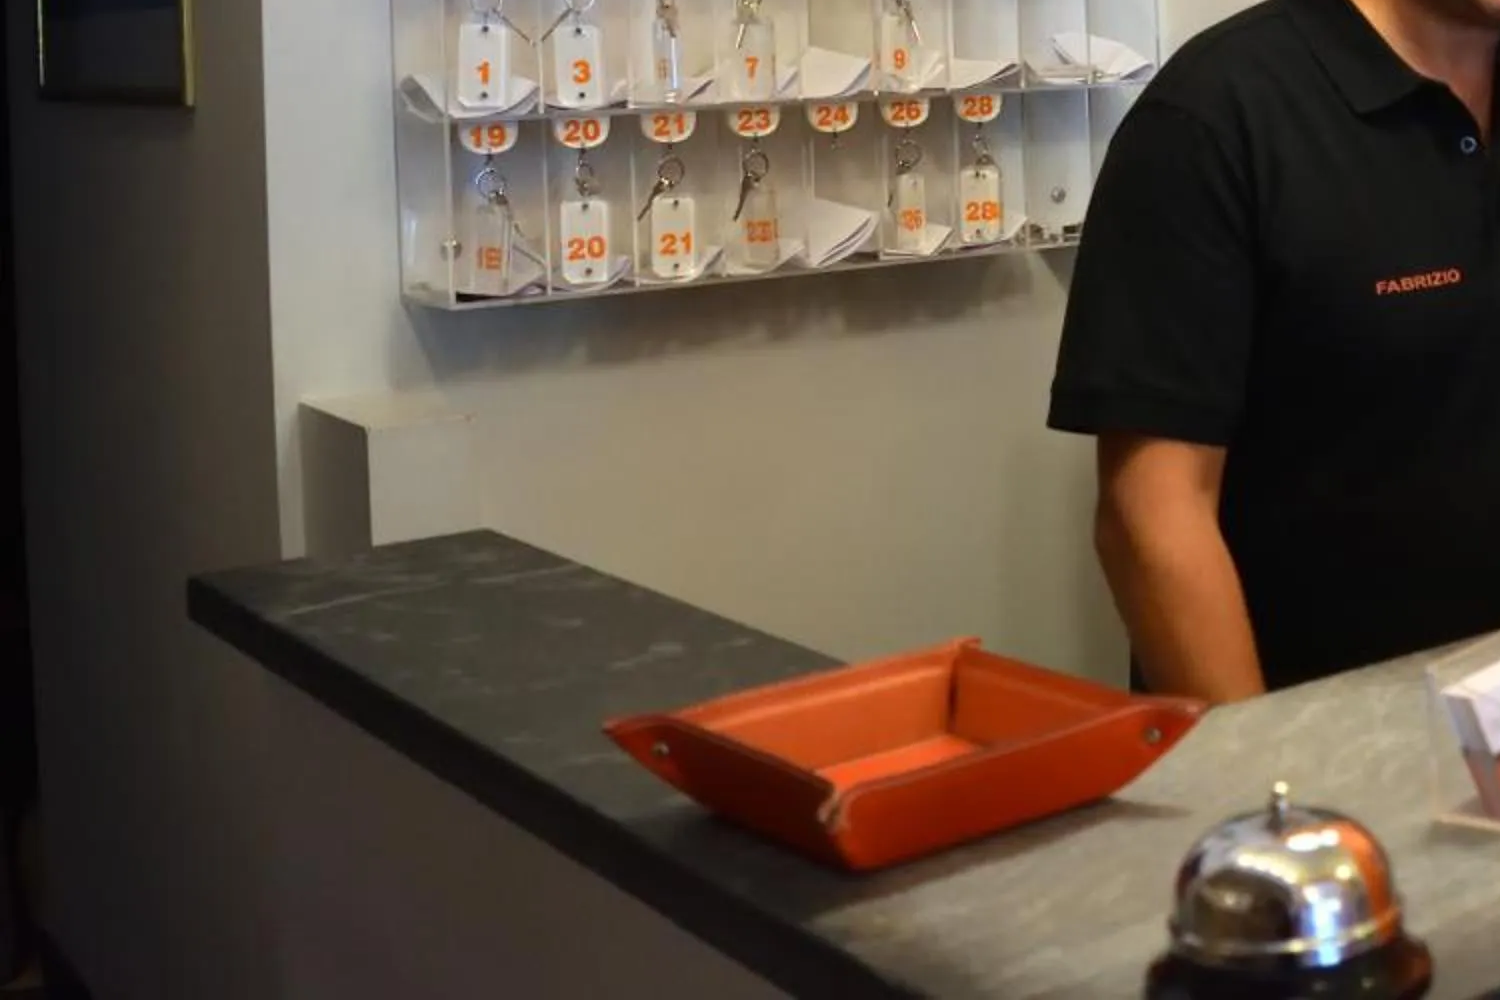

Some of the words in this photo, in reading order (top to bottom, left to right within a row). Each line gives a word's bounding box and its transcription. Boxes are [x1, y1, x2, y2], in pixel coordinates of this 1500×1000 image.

[573, 59, 592, 85] 3
[744, 55, 760, 81] 7
[892, 47, 908, 72] 9
[477, 60, 491, 85] 1
[816, 105, 849, 128] 24
[890, 100, 922, 122] 26
[962, 96, 994, 117] 28
[564, 119, 602, 144] 20
[652, 113, 687, 138] 21
[738, 108, 772, 132] 23
[470, 124, 507, 148] 19
[966, 200, 1002, 222] 28
[567, 236, 607, 262] 20
[659, 231, 694, 256] 21
[1376, 268, 1461, 295] FABRIZIO
